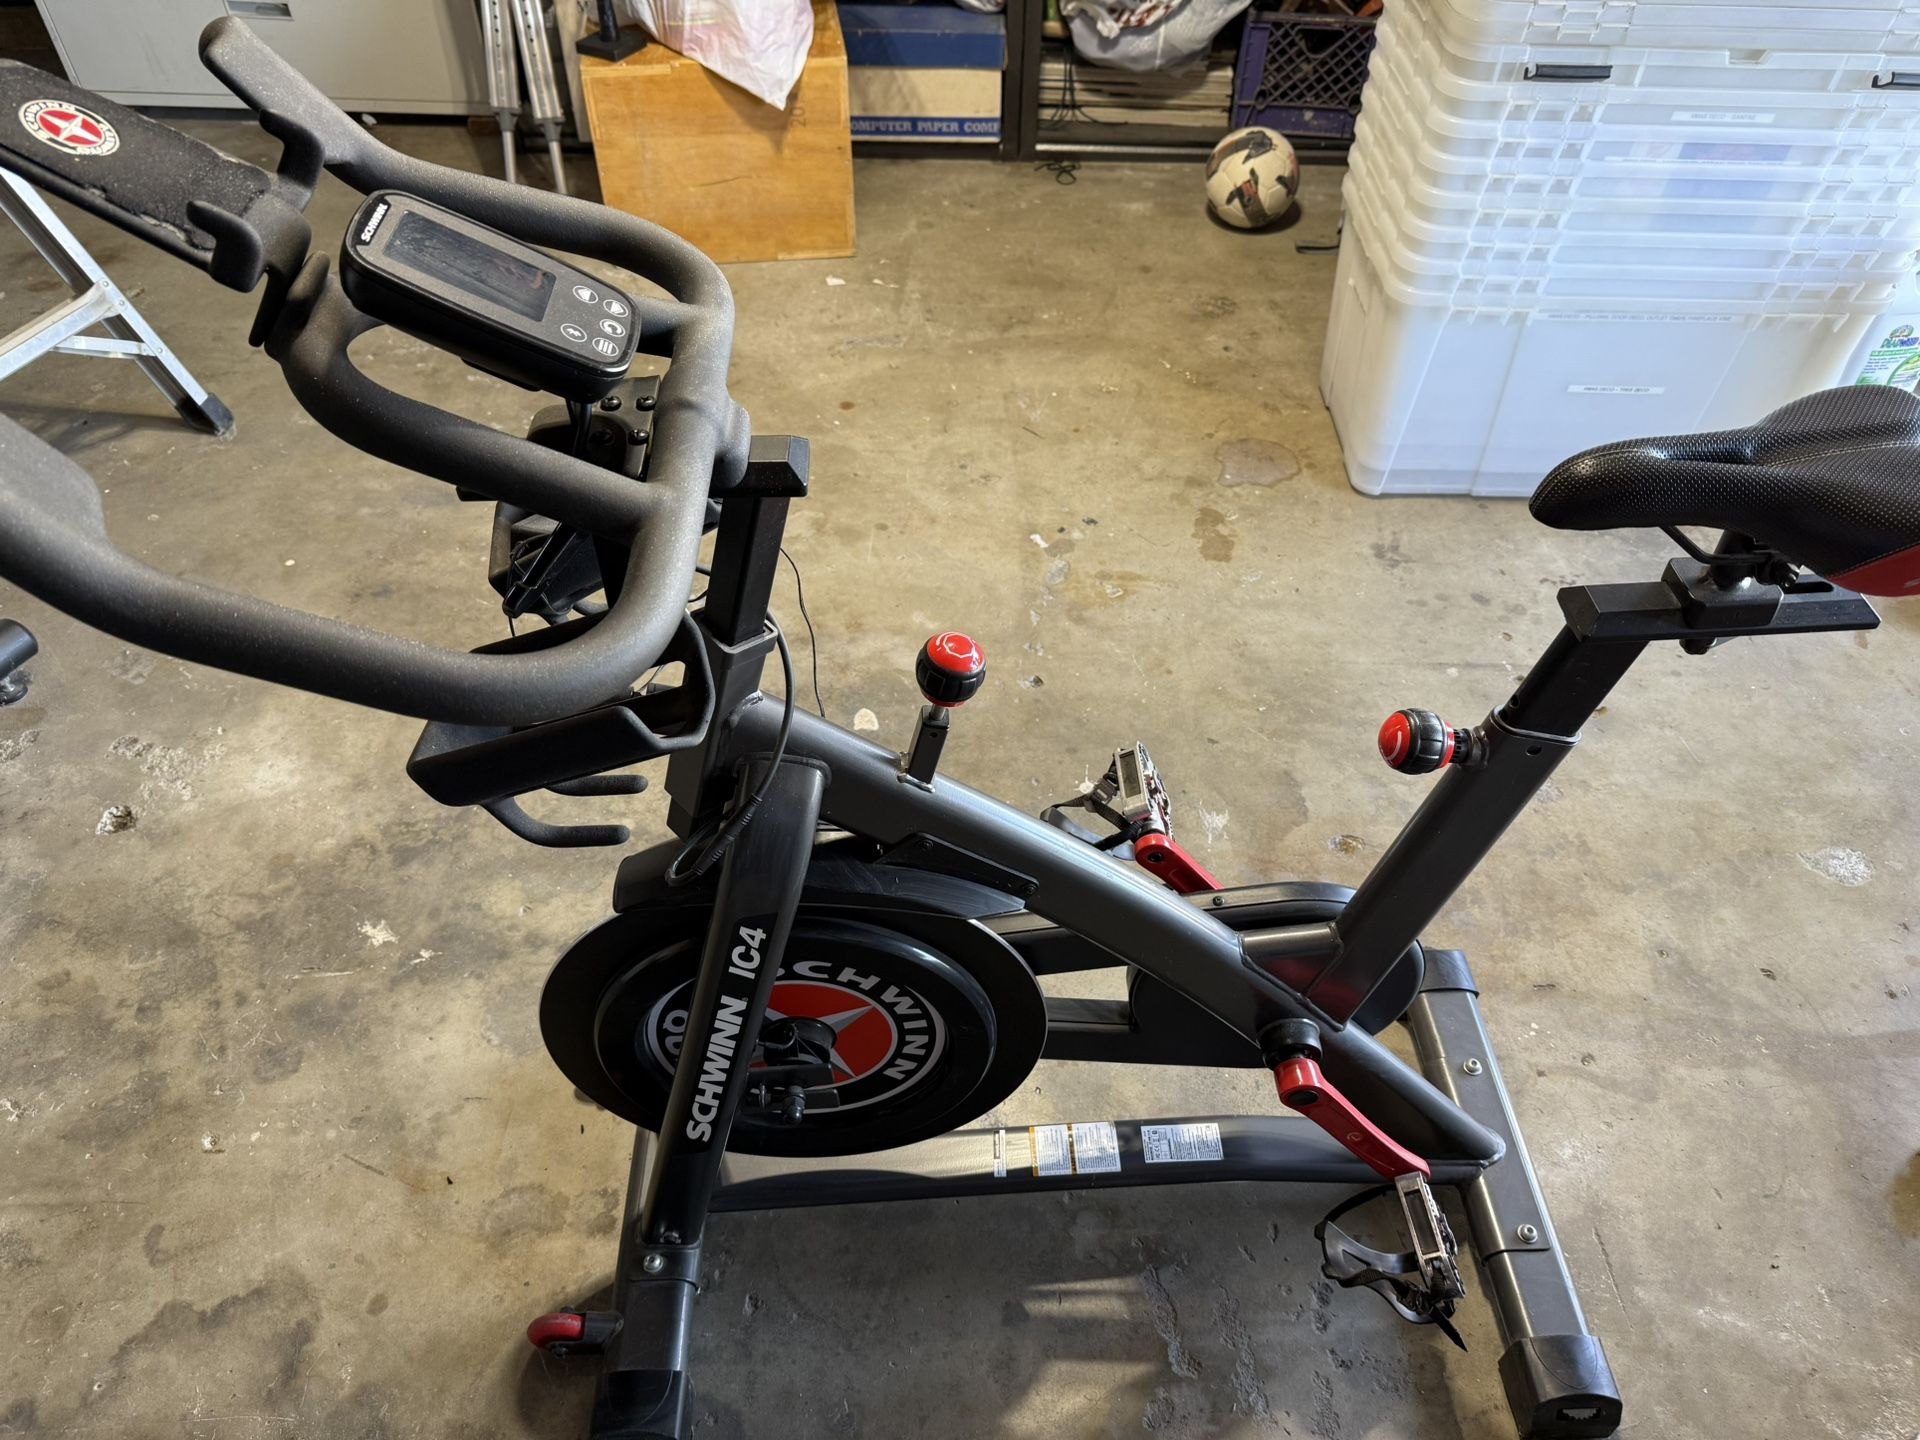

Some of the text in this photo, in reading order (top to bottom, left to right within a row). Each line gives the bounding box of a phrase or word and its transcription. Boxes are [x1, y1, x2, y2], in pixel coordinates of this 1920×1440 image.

[851, 120, 912, 132] OMPUTER
[917, 121, 960, 133] PAPER
[686, 925, 767, 1142] SCHWINN IC4
